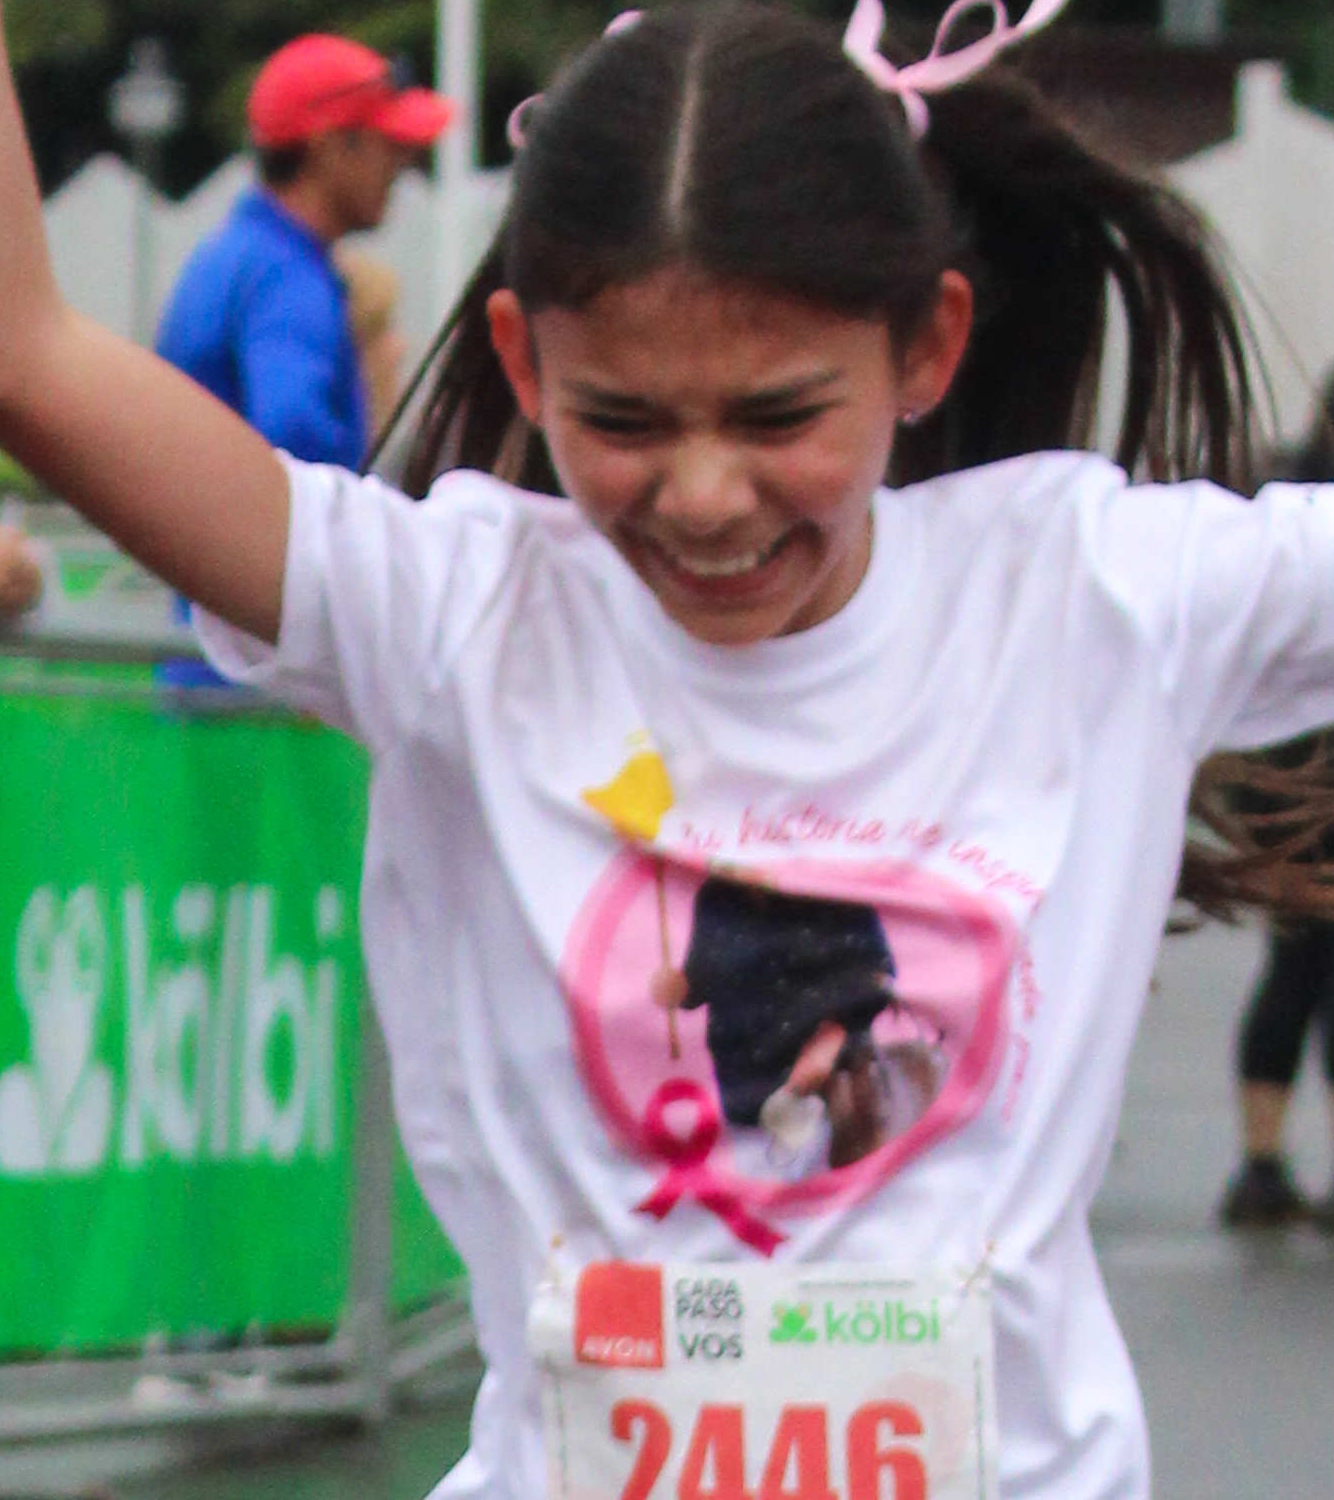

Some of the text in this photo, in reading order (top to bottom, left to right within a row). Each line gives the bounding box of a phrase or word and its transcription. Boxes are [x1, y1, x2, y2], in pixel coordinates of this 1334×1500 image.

[675, 1277, 738, 1298] CADA
[676, 1298, 743, 1320] PASO
[824, 1299, 941, 1344] kölbi
[581, 1334, 657, 1360] AVON
[679, 1332, 744, 1360] VOS
